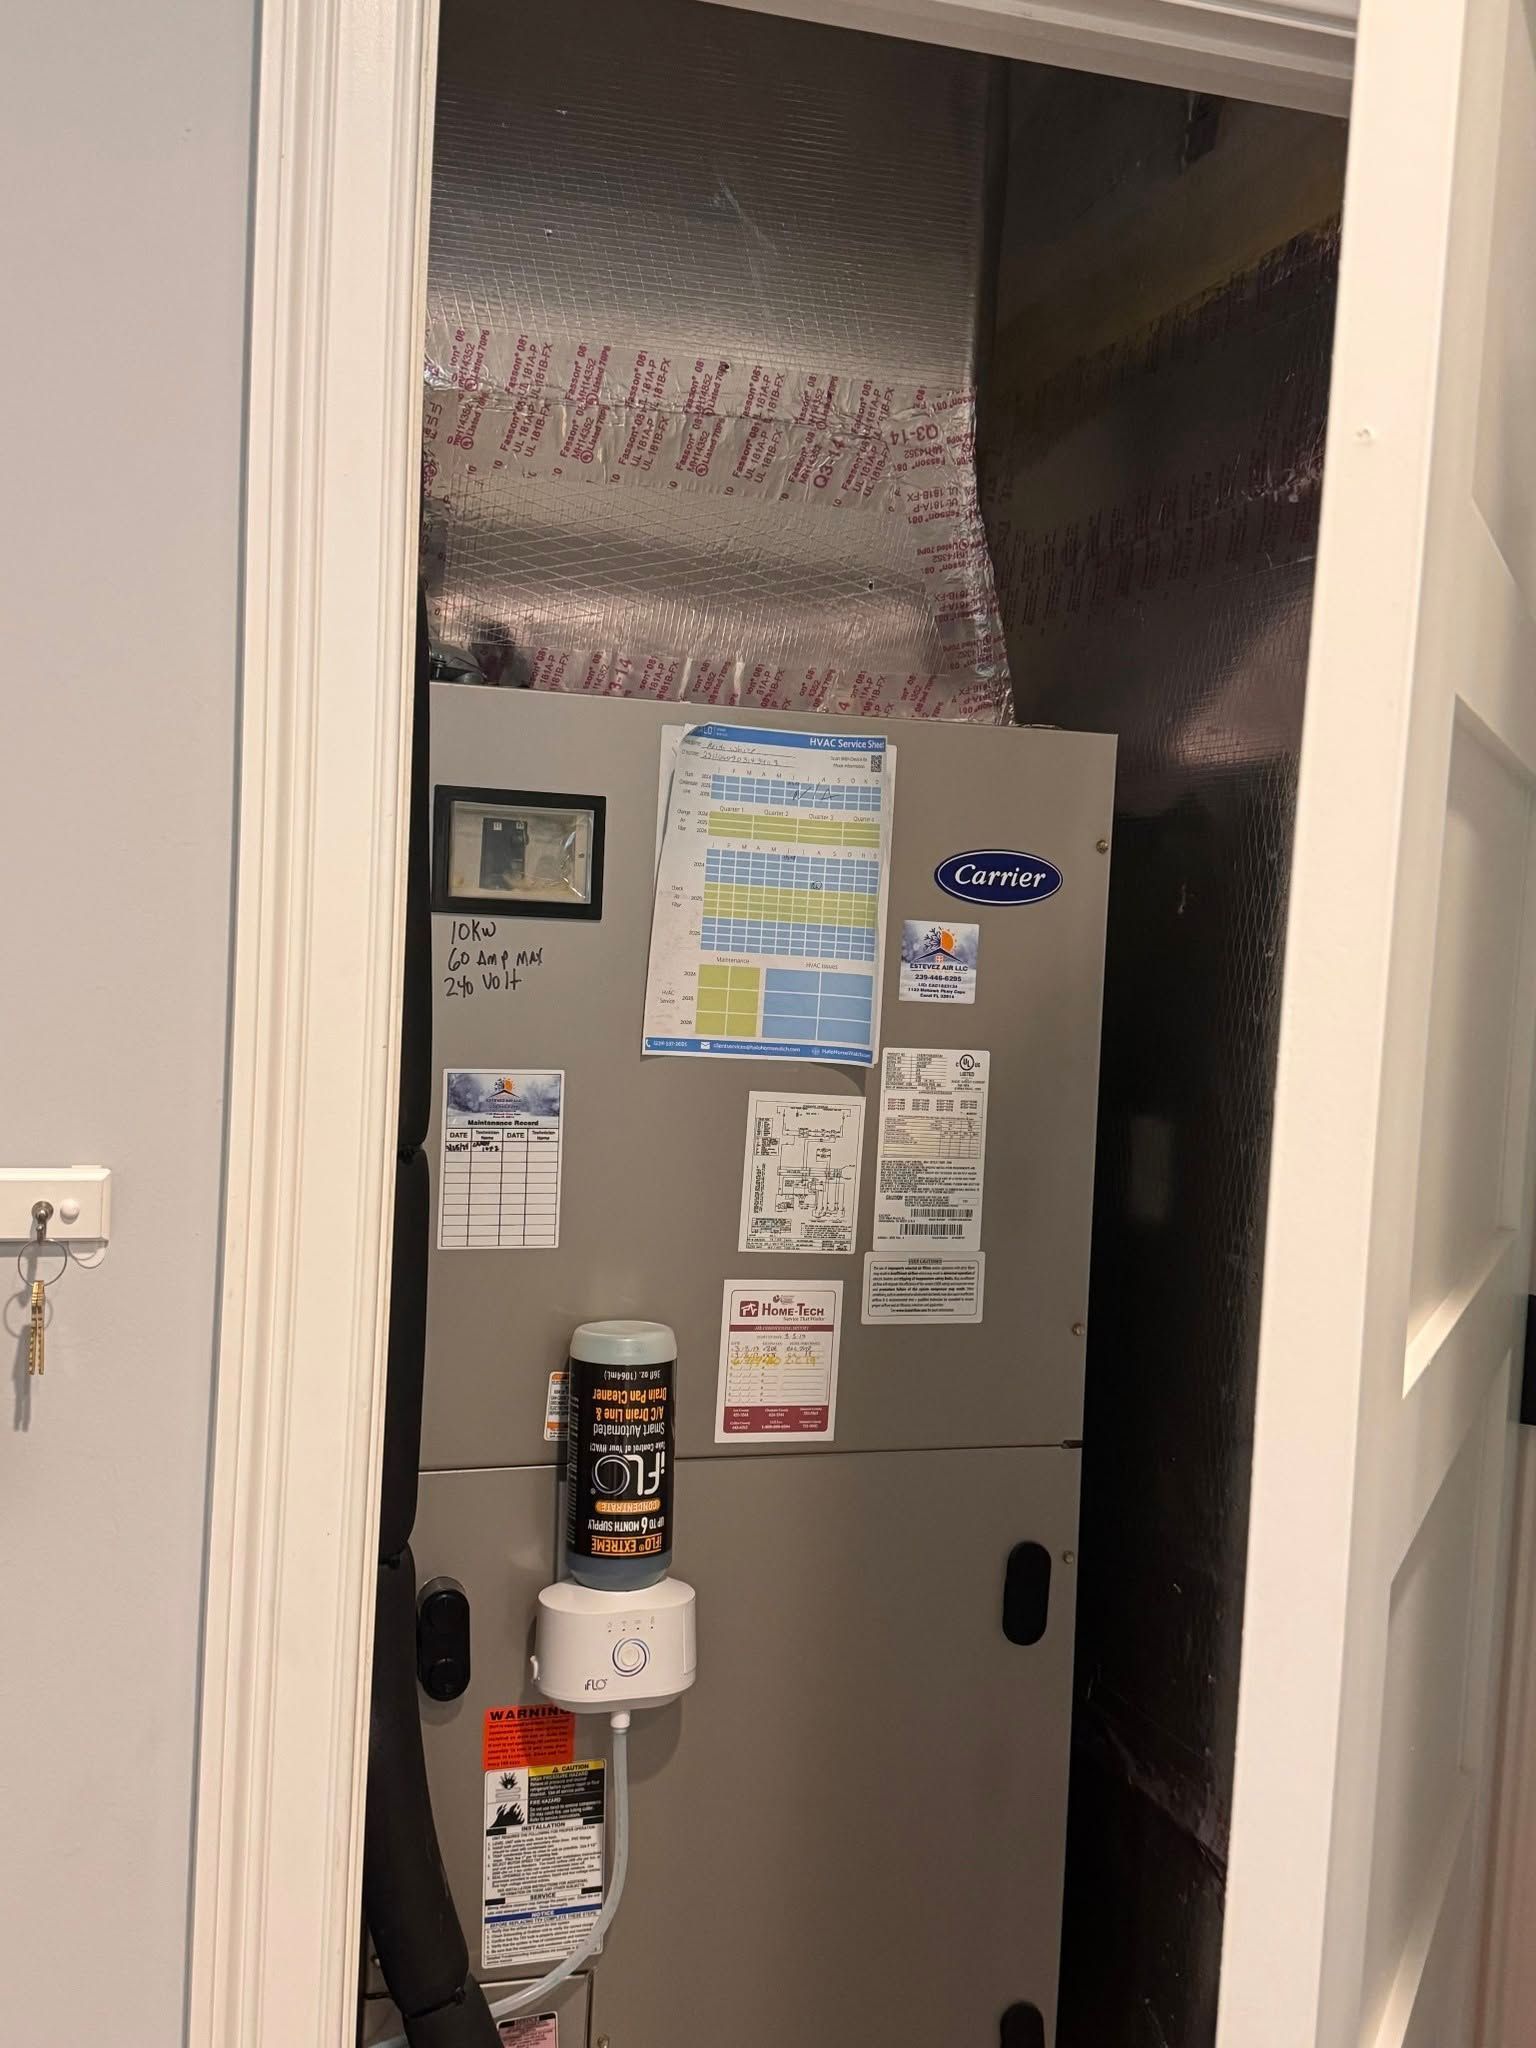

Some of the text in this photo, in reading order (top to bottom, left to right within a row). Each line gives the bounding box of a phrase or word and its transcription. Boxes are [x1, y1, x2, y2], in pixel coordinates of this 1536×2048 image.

[809, 738, 836, 747] HVAC
[838, 739, 866, 749] Service
[763, 809, 783, 817] Quarter
[954, 863, 1047, 888] Carrier
[448, 947, 470, 971] 60
[443, 975, 474, 999] 240
[467, 1119, 512, 1127] Maintenance
[592, 1387, 667, 1404] Drain Pan Cleaner
[595, 1406, 664, 1422] A/C Drain Line &
[593, 1422, 665, 1438] Smart Automated
[633, 1441, 654, 1454] Control
[587, 1519, 613, 1531] SUPPLY
[614, 1520, 640, 1532] MONTH
[640, 1516, 648, 1534] 6
[591, 1537, 637, 1553] EXTREME
[561, 1763, 590, 1772] CAUTION
[521, 1821, 566, 1832] INSTALLATION
[529, 1892, 556, 1901] SERVICE
